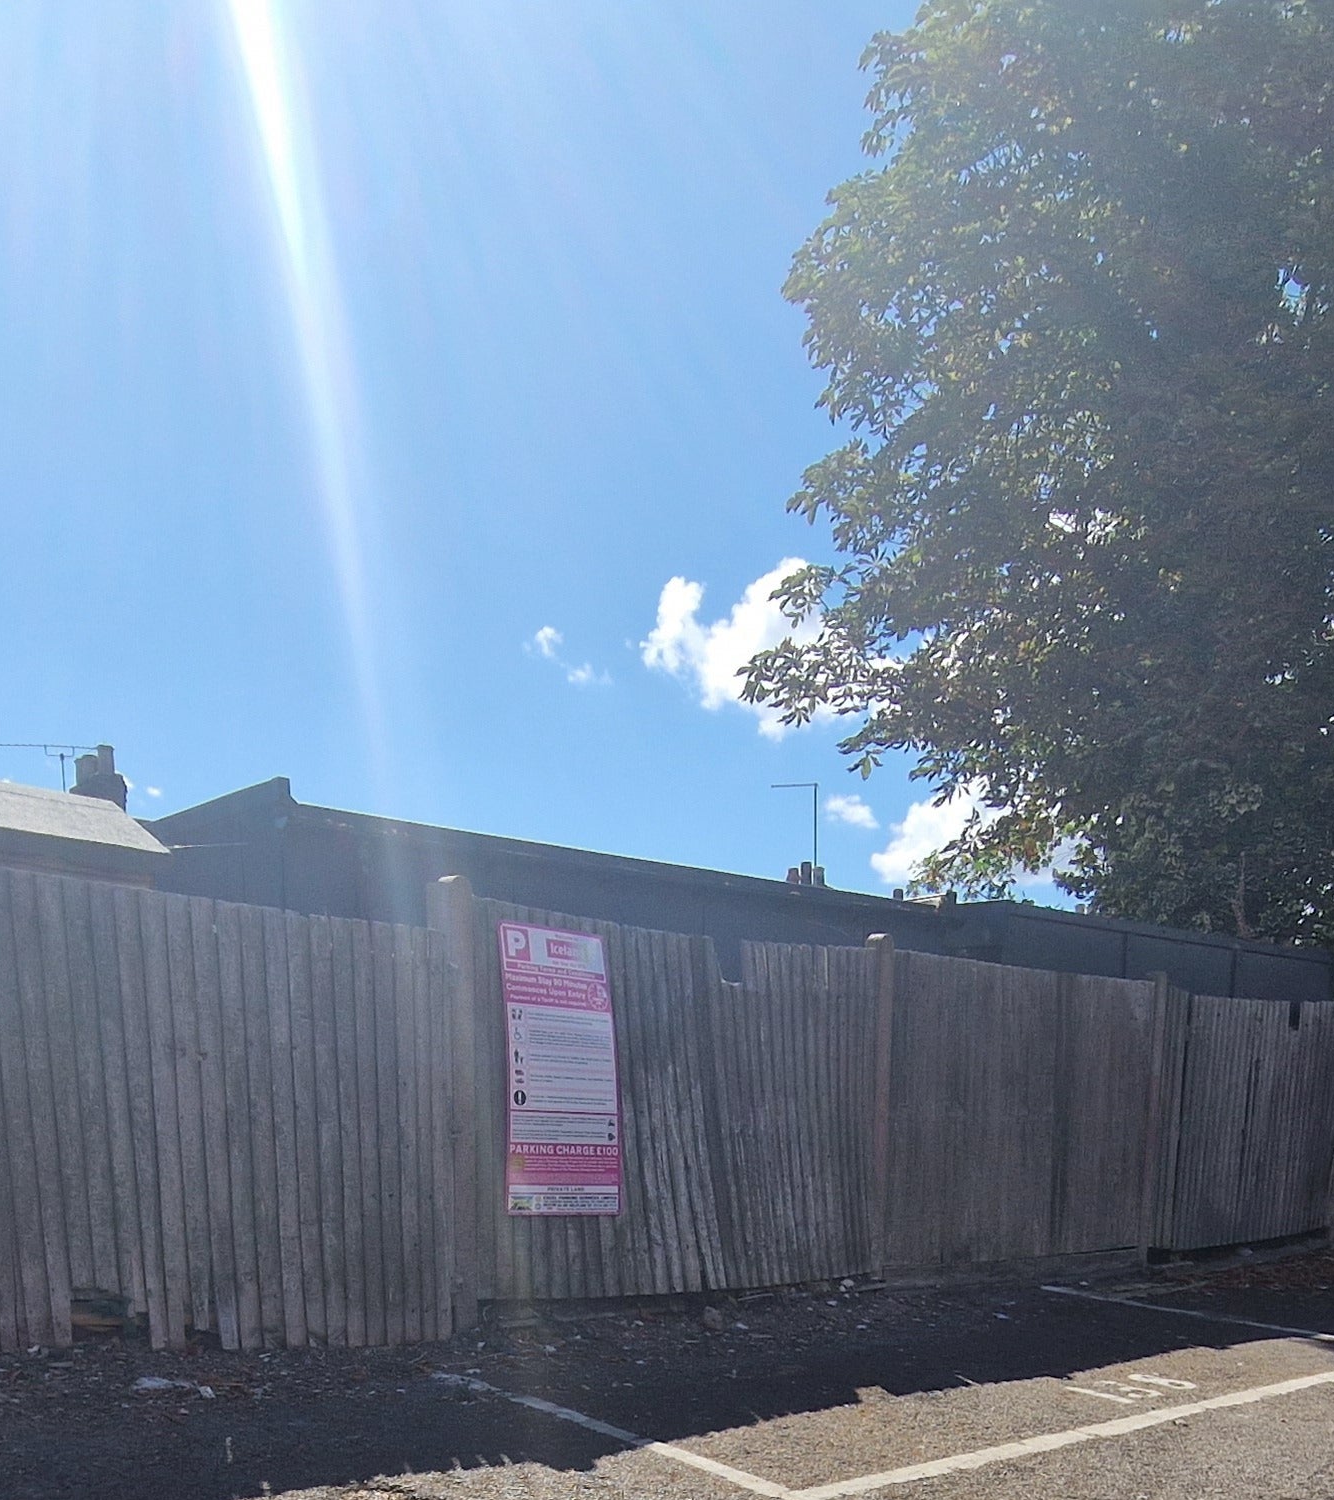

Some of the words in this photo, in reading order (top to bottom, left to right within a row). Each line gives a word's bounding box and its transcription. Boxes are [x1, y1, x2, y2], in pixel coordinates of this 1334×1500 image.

[506, 929, 527, 957] P
[505, 972, 537, 983] Maximum
[548, 988, 566, 997] Upon
[568, 990, 586, 1000] Entry
[509, 1144, 554, 1154] PARKING
[556, 1145, 595, 1155] CHARGE
[596, 1146, 619, 1156] £100
[1065, 1373, 1197, 1404] 138
